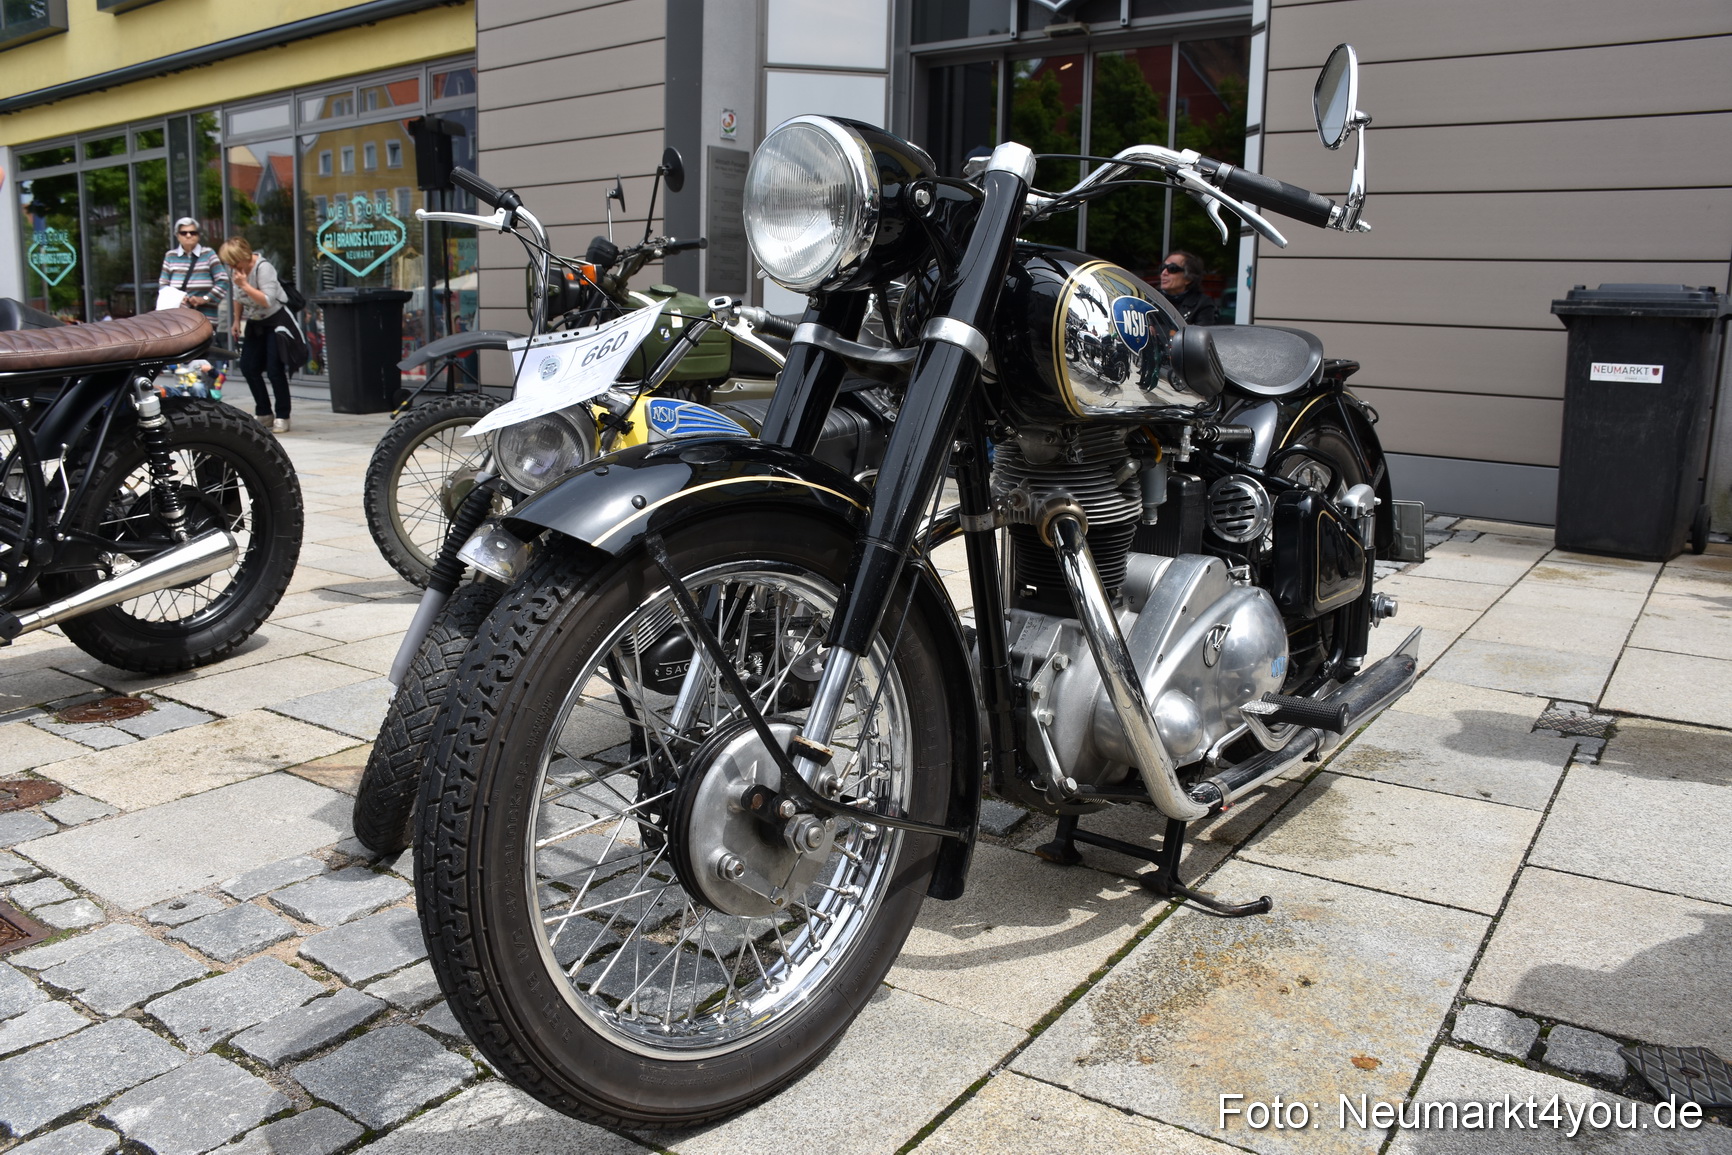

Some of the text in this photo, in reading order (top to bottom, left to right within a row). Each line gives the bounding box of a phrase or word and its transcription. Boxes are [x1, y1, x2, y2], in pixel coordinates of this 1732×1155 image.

[327, 200, 392, 218] WELCOME
[336, 231, 362, 248] BRANDS
[362, 231, 368, 247] &
[368, 229, 397, 247] CITIZENS
[345, 249, 375, 260] NEUMARKT
[1123, 309, 1146, 337] NSU
[581, 330, 629, 368] 660
[1593, 365, 1650, 376] NEUMARKT
[652, 406, 676, 423] NSU
[665, 662, 691, 676] SAC
